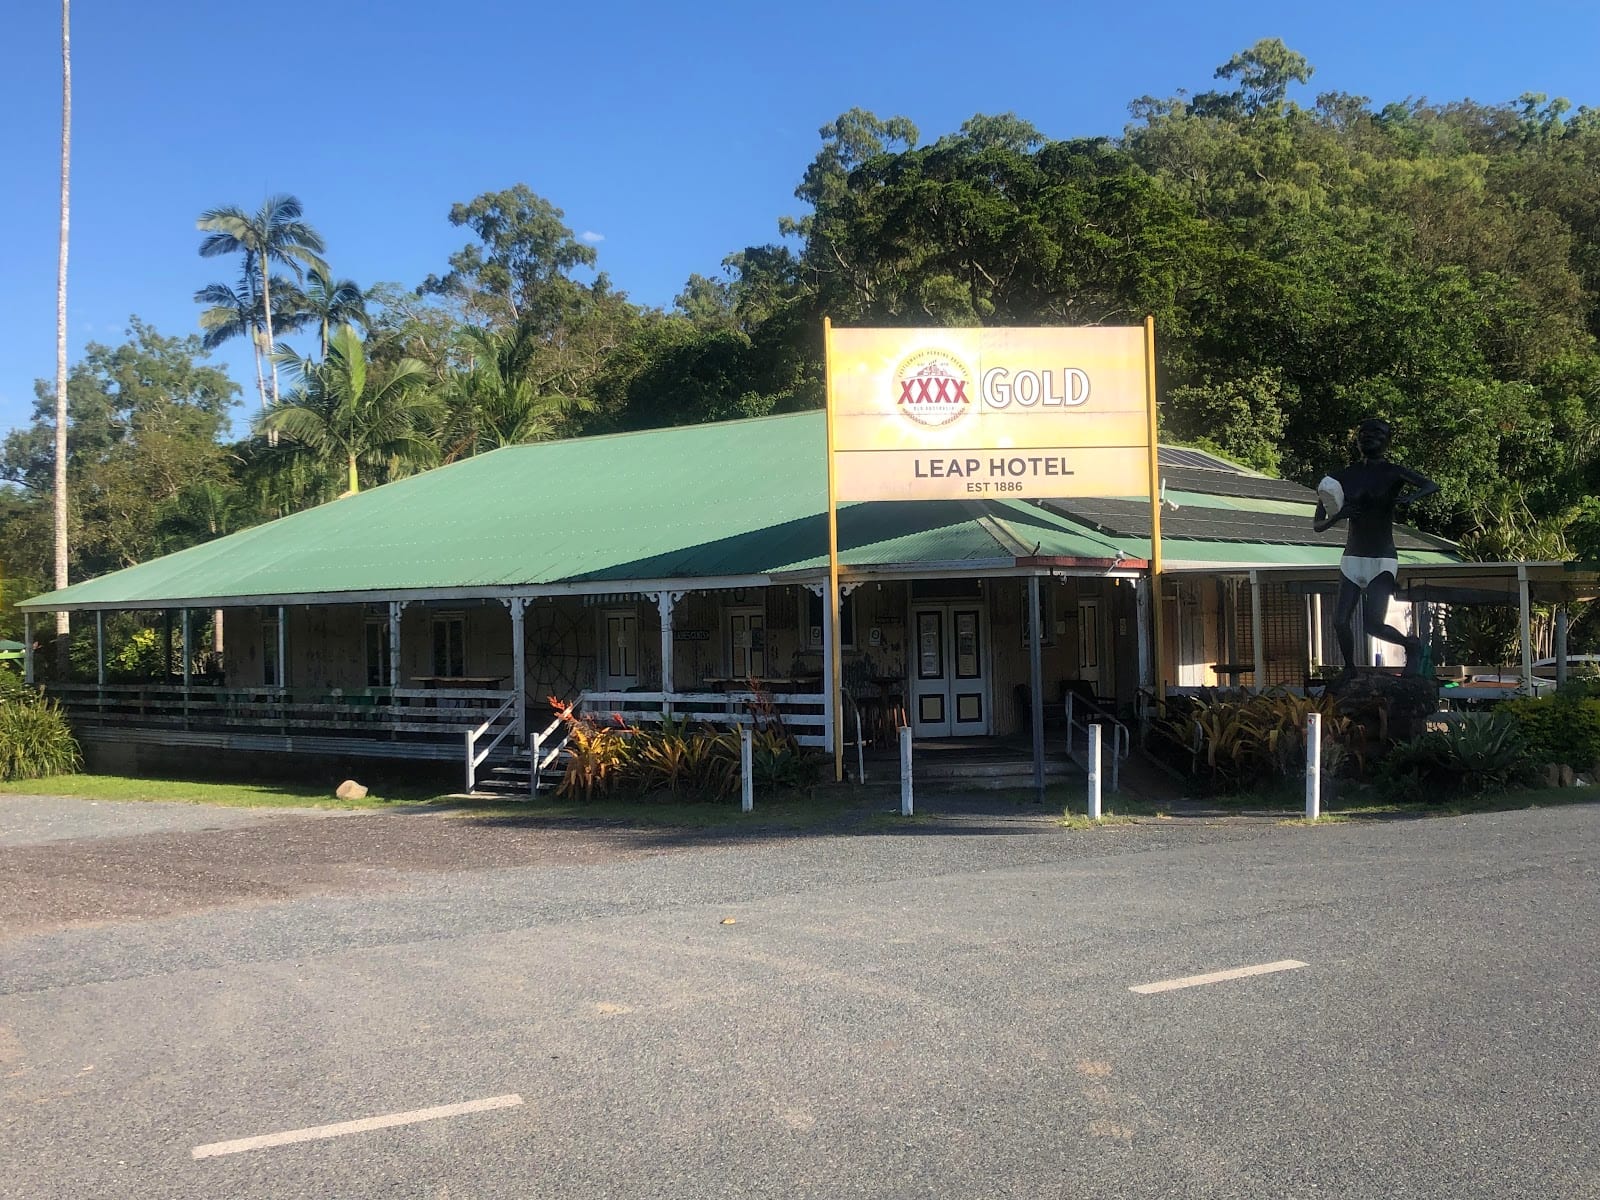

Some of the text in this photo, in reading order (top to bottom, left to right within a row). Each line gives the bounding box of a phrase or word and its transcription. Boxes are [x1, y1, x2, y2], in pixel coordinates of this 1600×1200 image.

[897, 366, 1091, 410] XXXX GOLD
[914, 457, 1074, 479] LEAP HOTEL
[966, 481, 1023, 493] EST 1886
